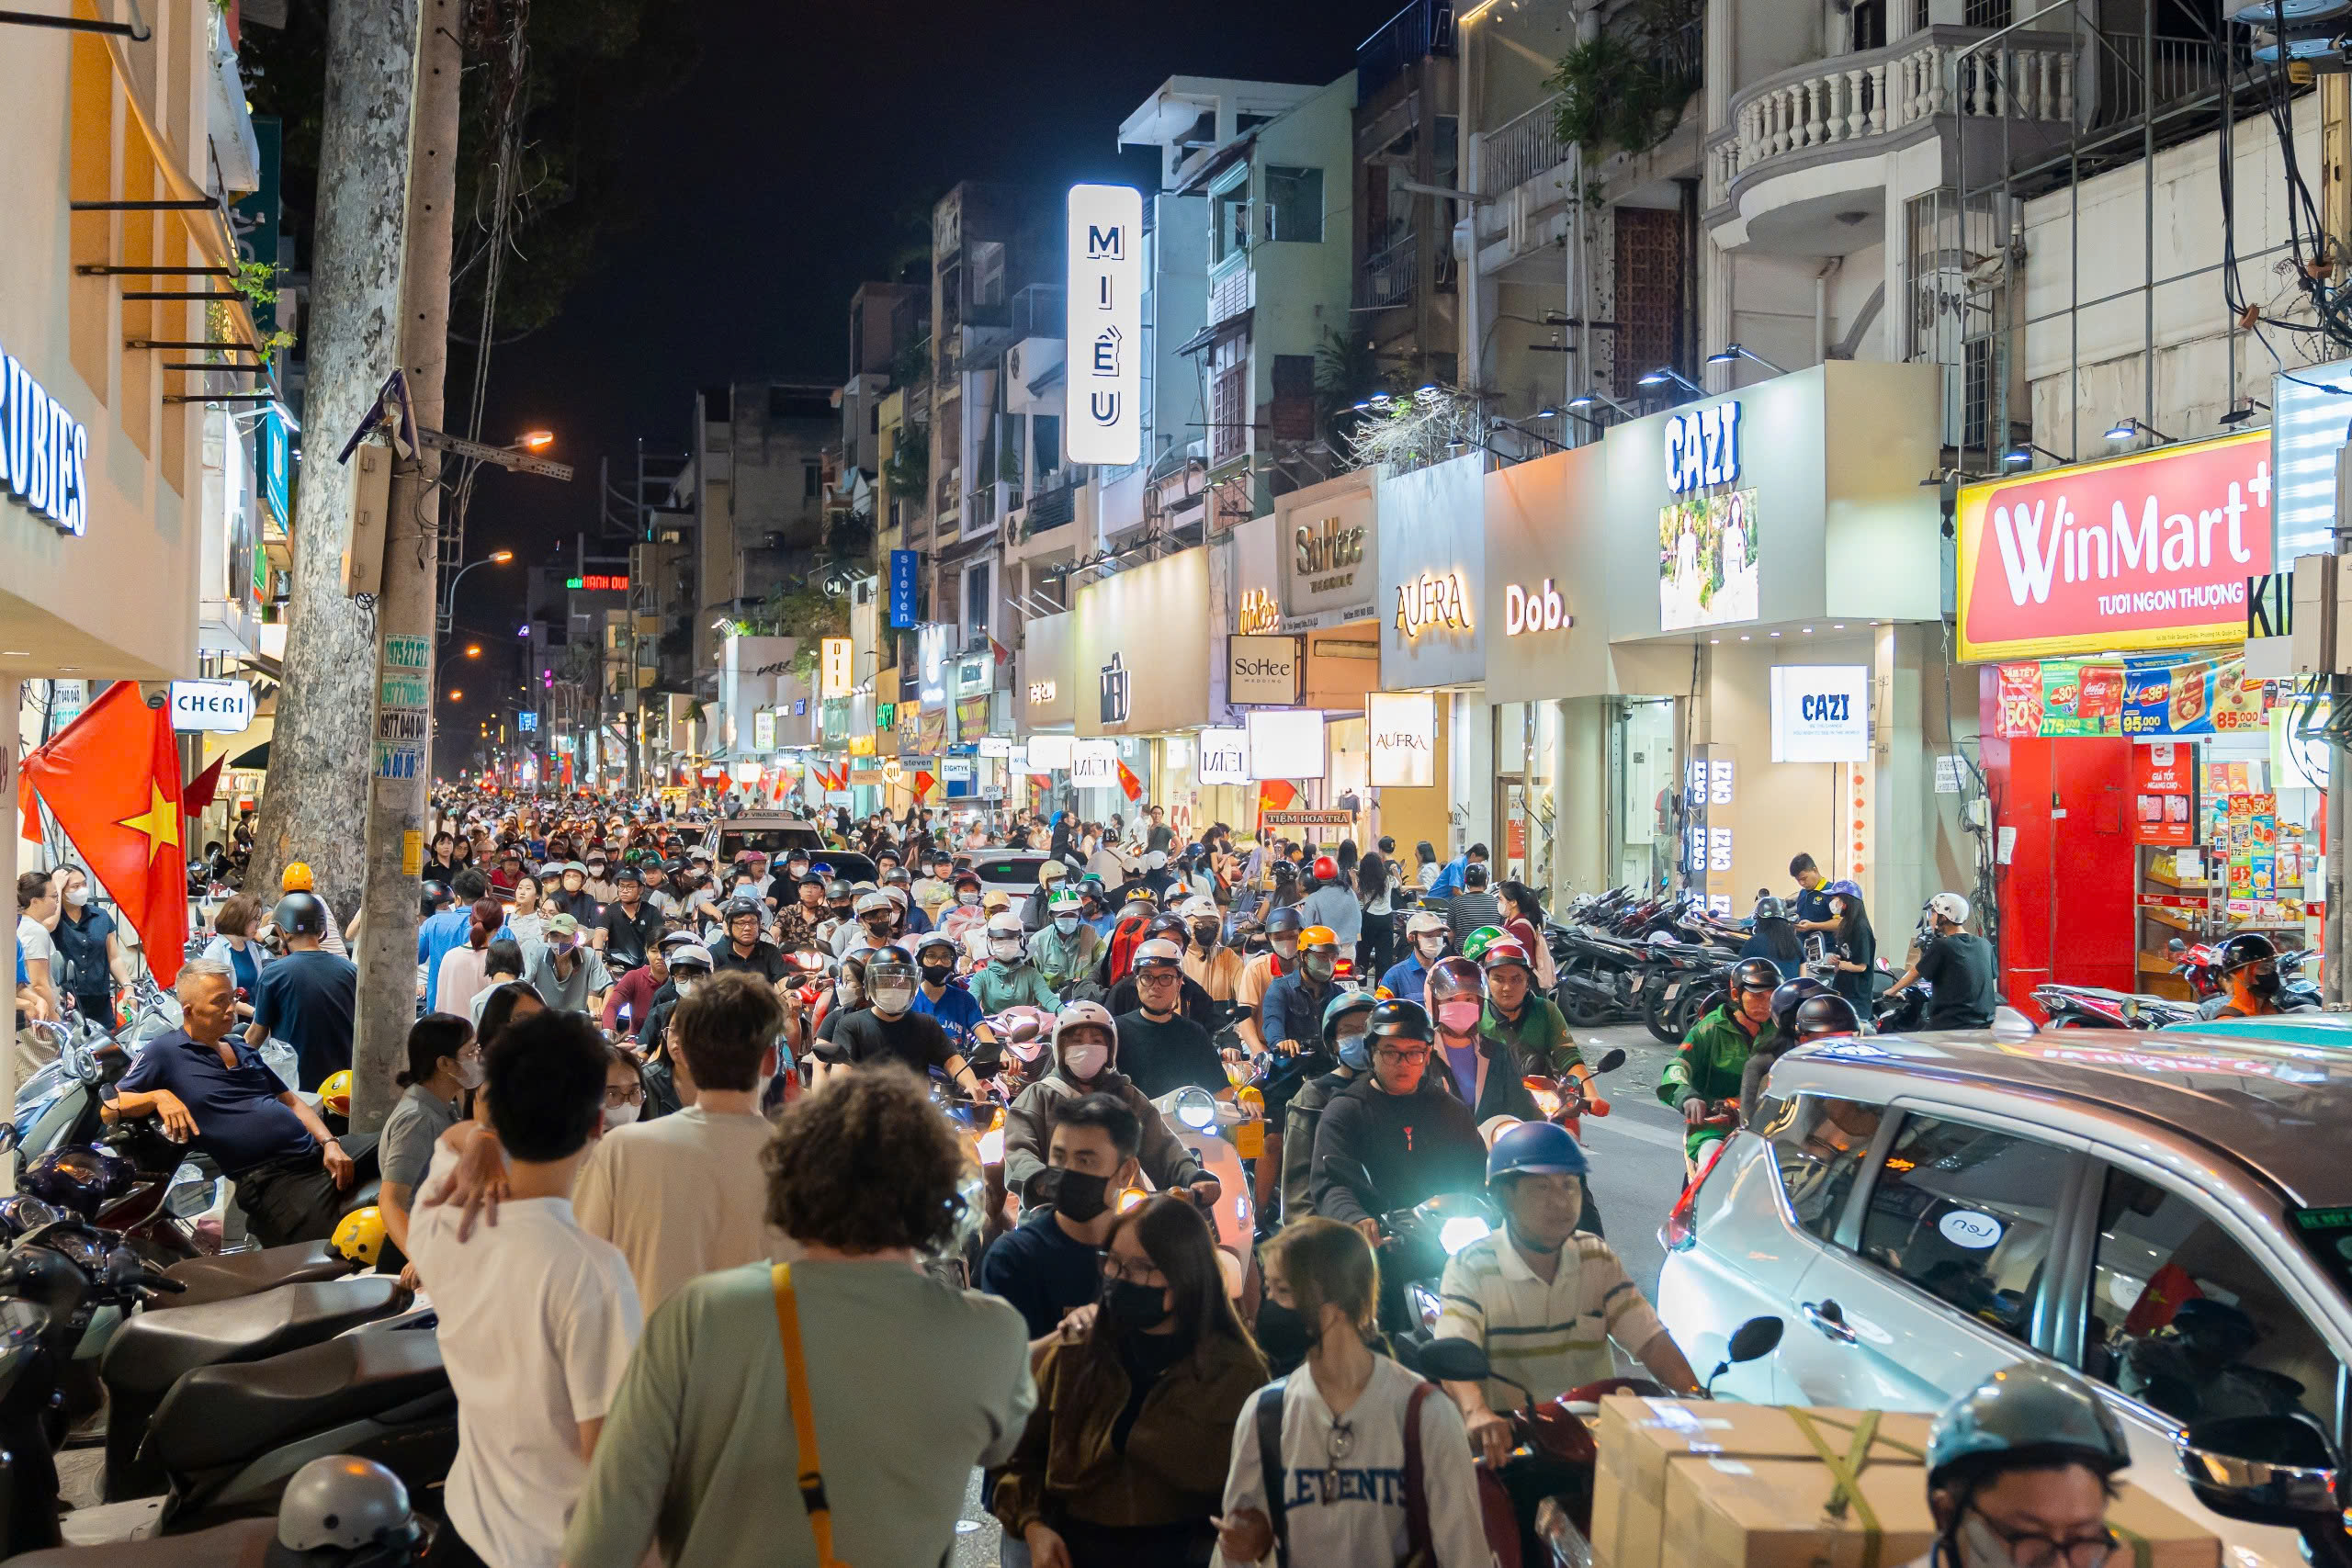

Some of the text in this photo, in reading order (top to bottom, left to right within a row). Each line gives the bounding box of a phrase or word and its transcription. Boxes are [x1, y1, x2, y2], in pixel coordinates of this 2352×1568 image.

[1664, 400, 1741, 493] CAZI
[1296, 517, 1363, 575] SoHee
[899, 555, 909, 622] steven
[1394, 573, 1473, 637] AUFRA
[1507, 579, 1573, 636] Dob.
[2132, 589, 2177, 613] NGON
[1235, 659, 1290, 676] SoHee
[1803, 694, 1849, 721] CAZI
[1375, 731, 1429, 751] AUFRA
[1694, 761, 1707, 804] CAZI
[1711, 761, 1732, 804] CAZI
[1268, 811, 1348, 825] TIỆM HOA TRÀ
[1453, 814, 1461, 826] 92
[1693, 827, 1706, 871] CAZI
[1711, 828, 1731, 871] CAZI
